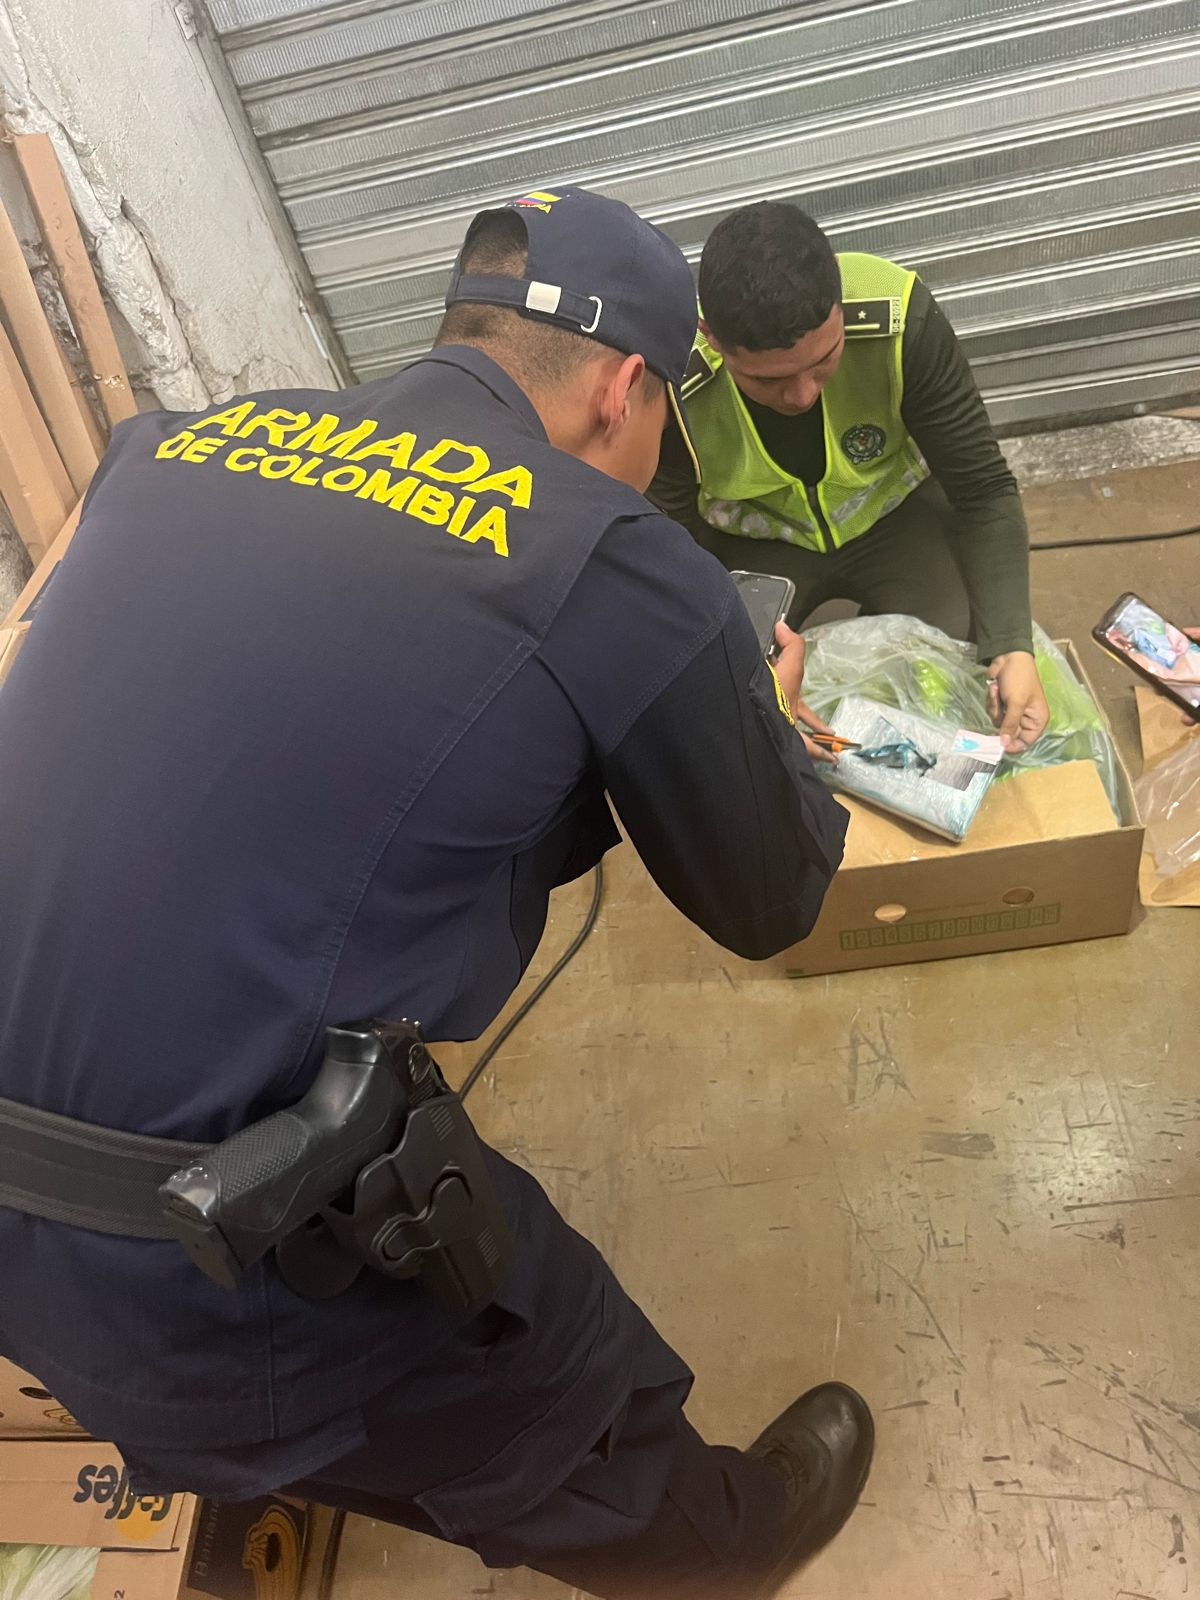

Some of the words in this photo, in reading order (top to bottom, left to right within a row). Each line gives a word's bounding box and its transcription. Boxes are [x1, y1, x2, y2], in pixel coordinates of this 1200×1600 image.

[155, 431, 229, 463] DE
[224, 447, 509, 557] COLOMBIA
[188, 401, 533, 509] ARMADA
